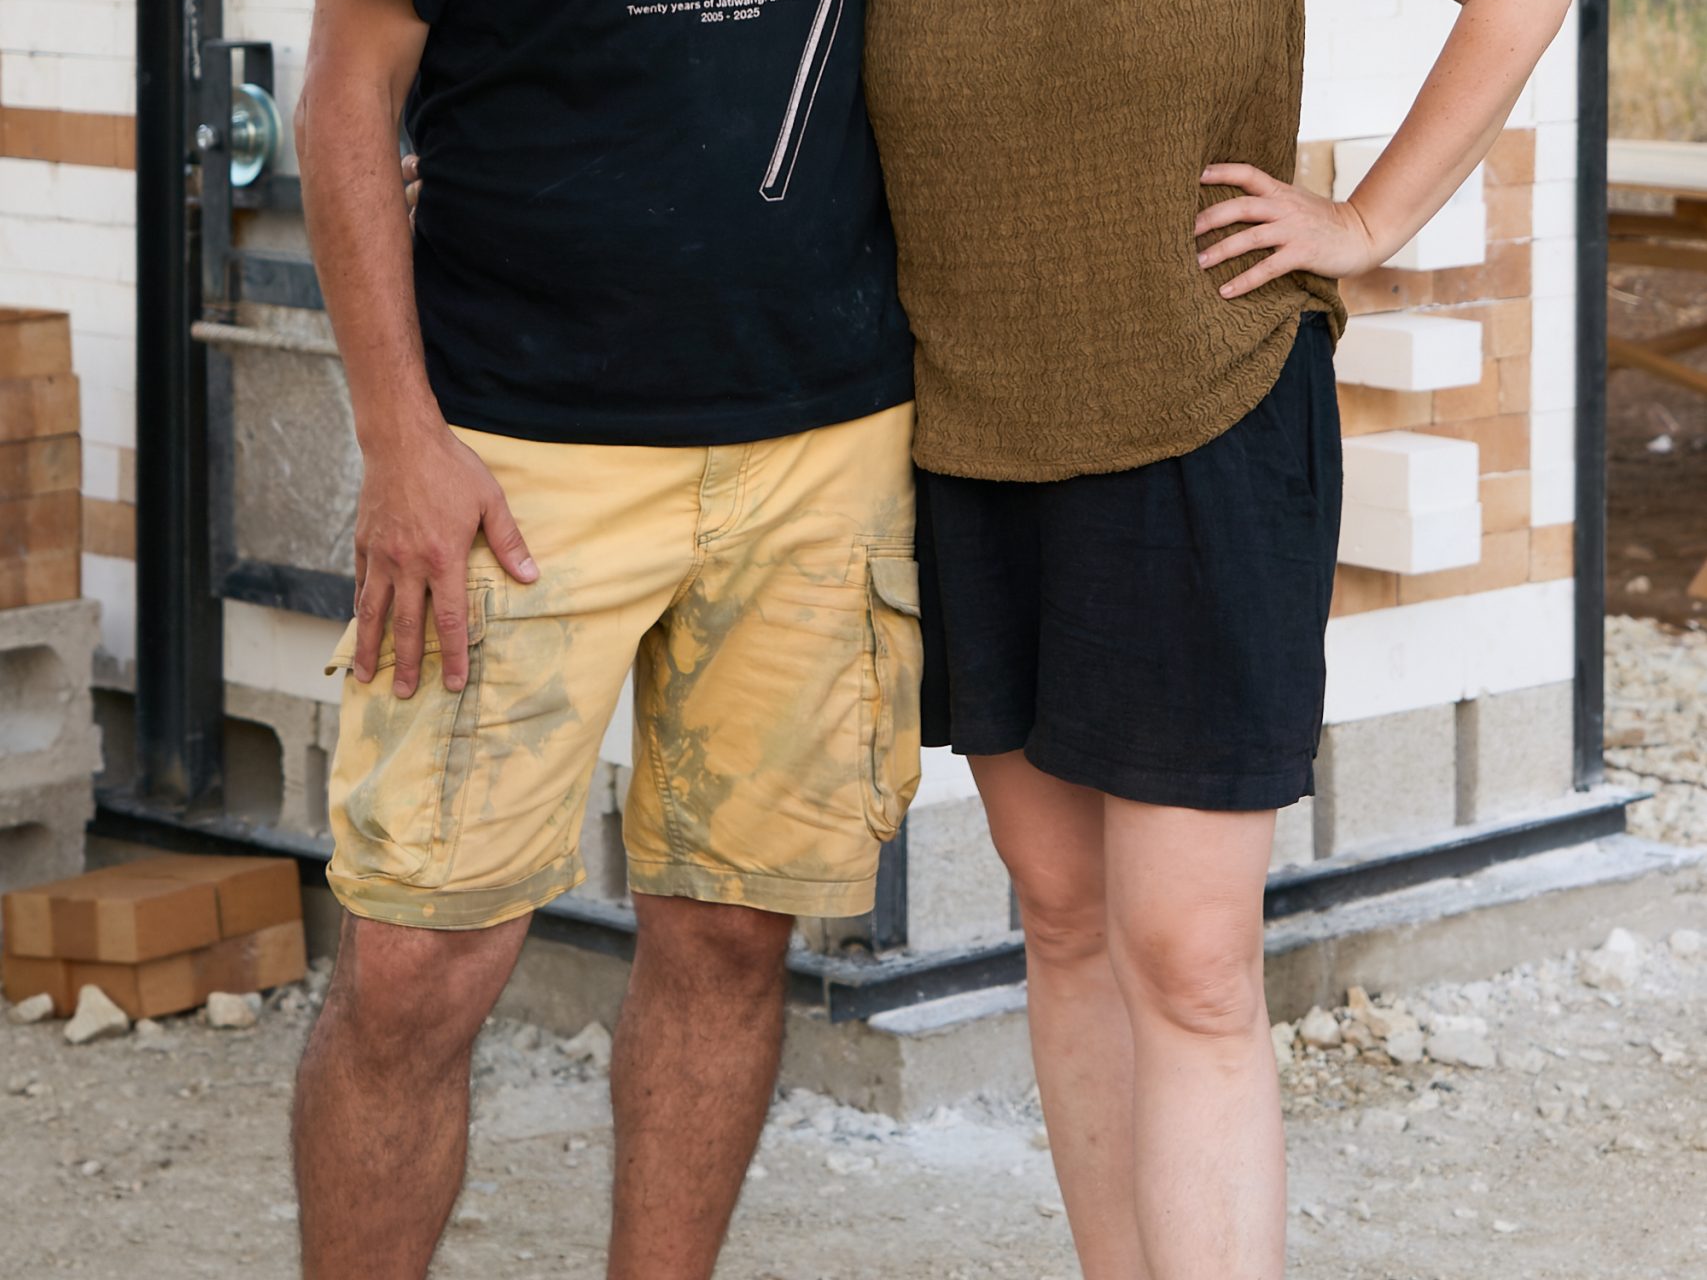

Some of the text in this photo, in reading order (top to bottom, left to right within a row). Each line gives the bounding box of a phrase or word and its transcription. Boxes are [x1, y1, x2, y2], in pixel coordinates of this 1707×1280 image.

[627, 4, 668, 17] Twenty
[671, 0, 701, 13] years
[700, 11, 724, 23] 2005
[733, 7, 760, 21] 2025
